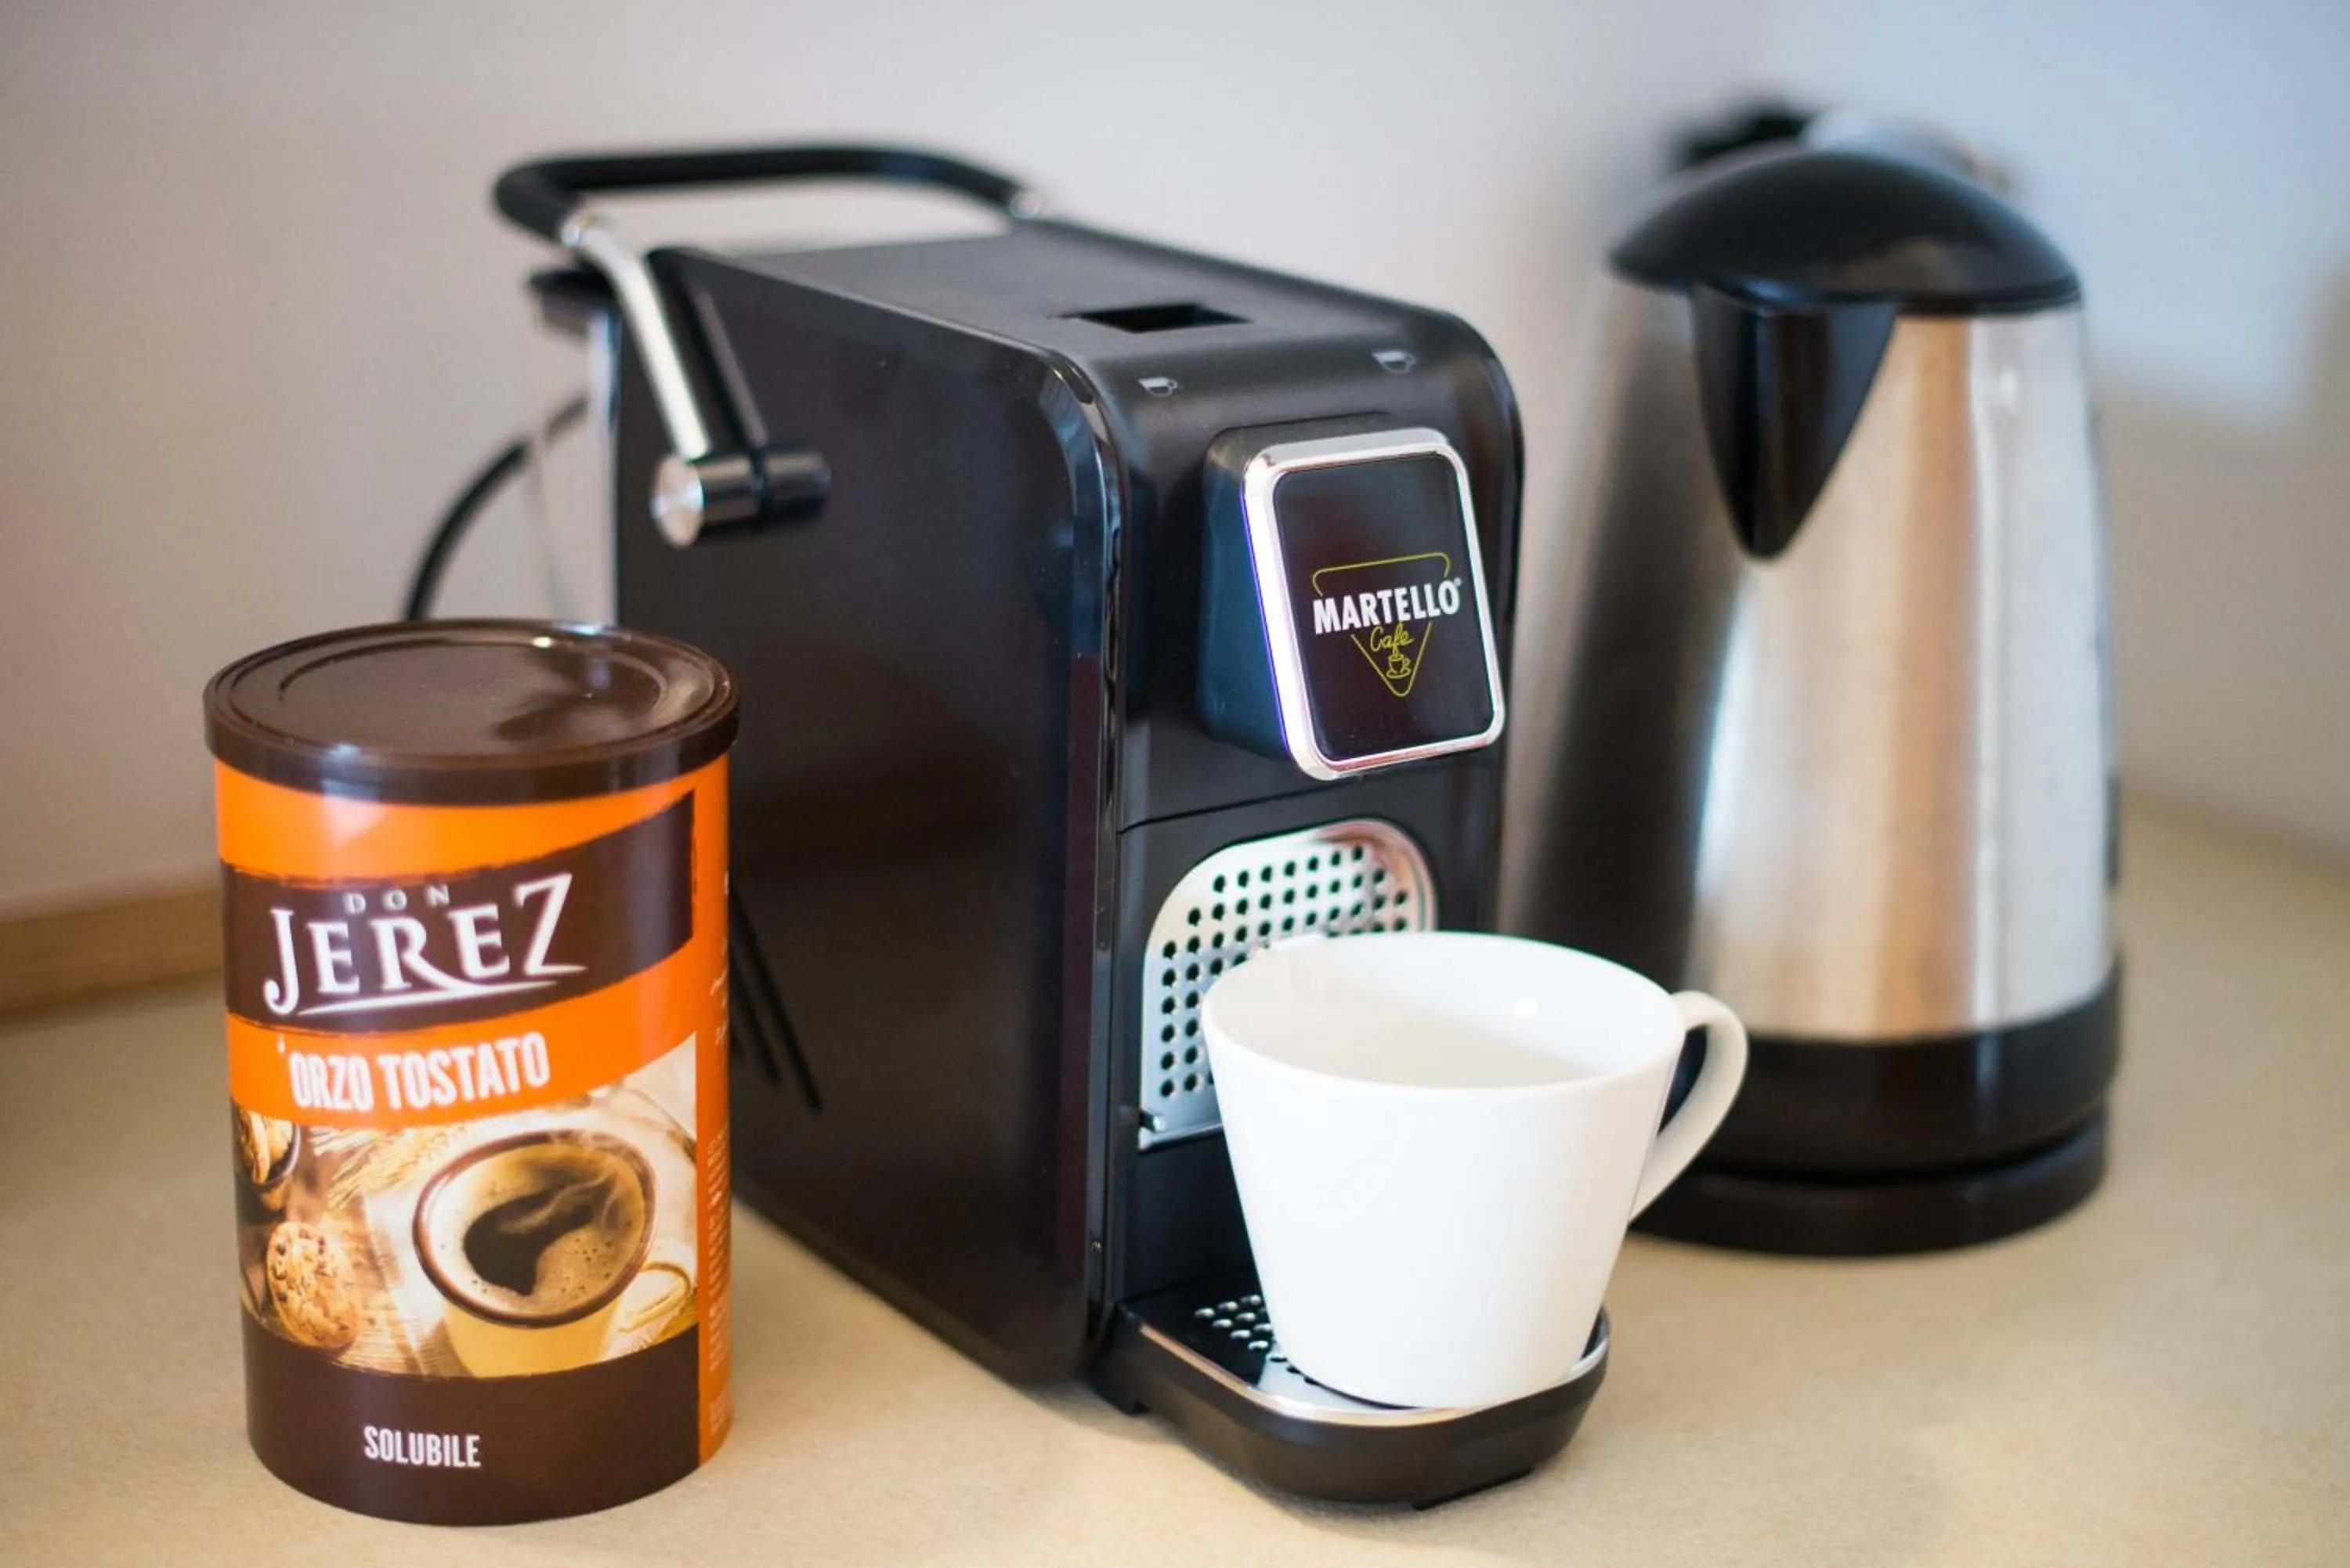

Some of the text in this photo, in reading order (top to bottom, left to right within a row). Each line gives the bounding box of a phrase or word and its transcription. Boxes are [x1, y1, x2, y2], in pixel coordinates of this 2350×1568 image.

[1312, 580, 1460, 635] MARTELLO
[345, 886, 450, 913] DON
[262, 872, 588, 1016] JEREZ
[289, 1031, 551, 1111] ORZO TOSTATO
[363, 1425, 482, 1468] SOLUBILE
